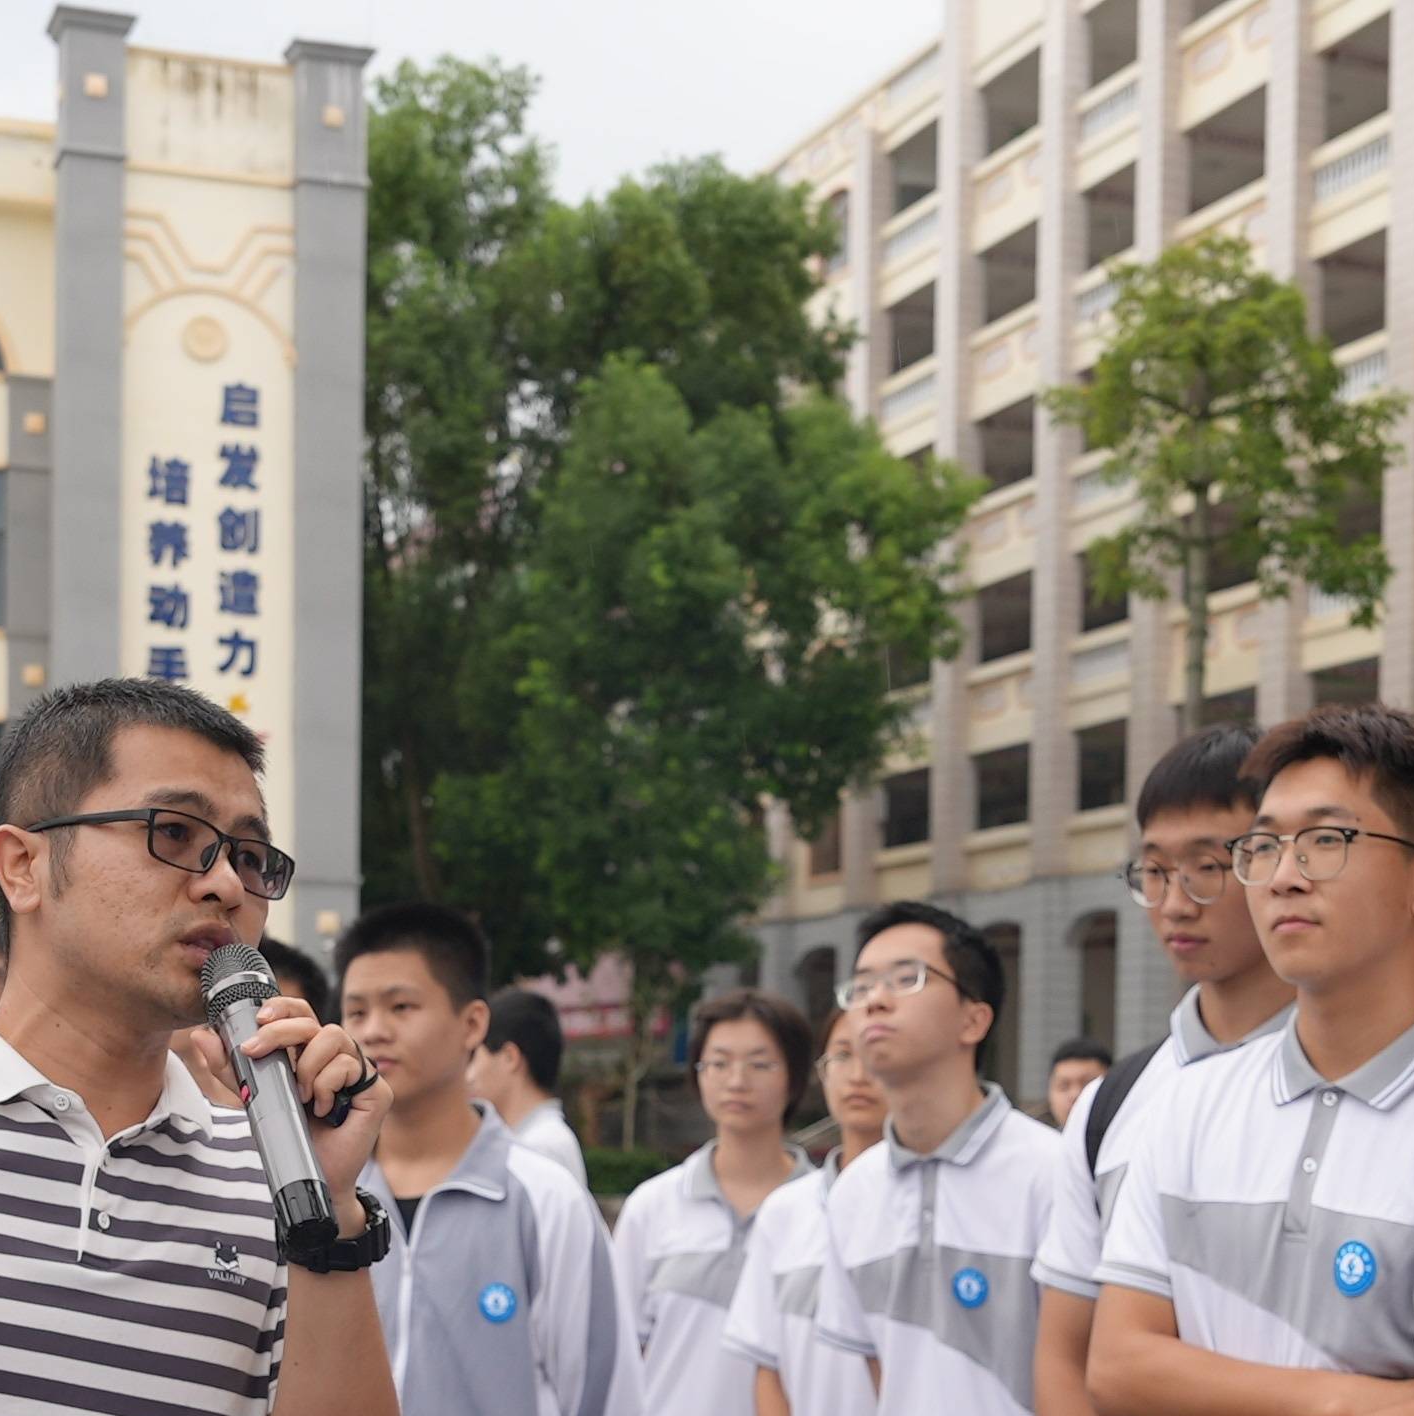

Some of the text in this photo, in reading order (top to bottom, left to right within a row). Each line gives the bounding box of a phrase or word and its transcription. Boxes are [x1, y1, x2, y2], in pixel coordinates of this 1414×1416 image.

[217, 383, 261, 678] 启发创造力
[207, 1269, 247, 1286] VALIANT
